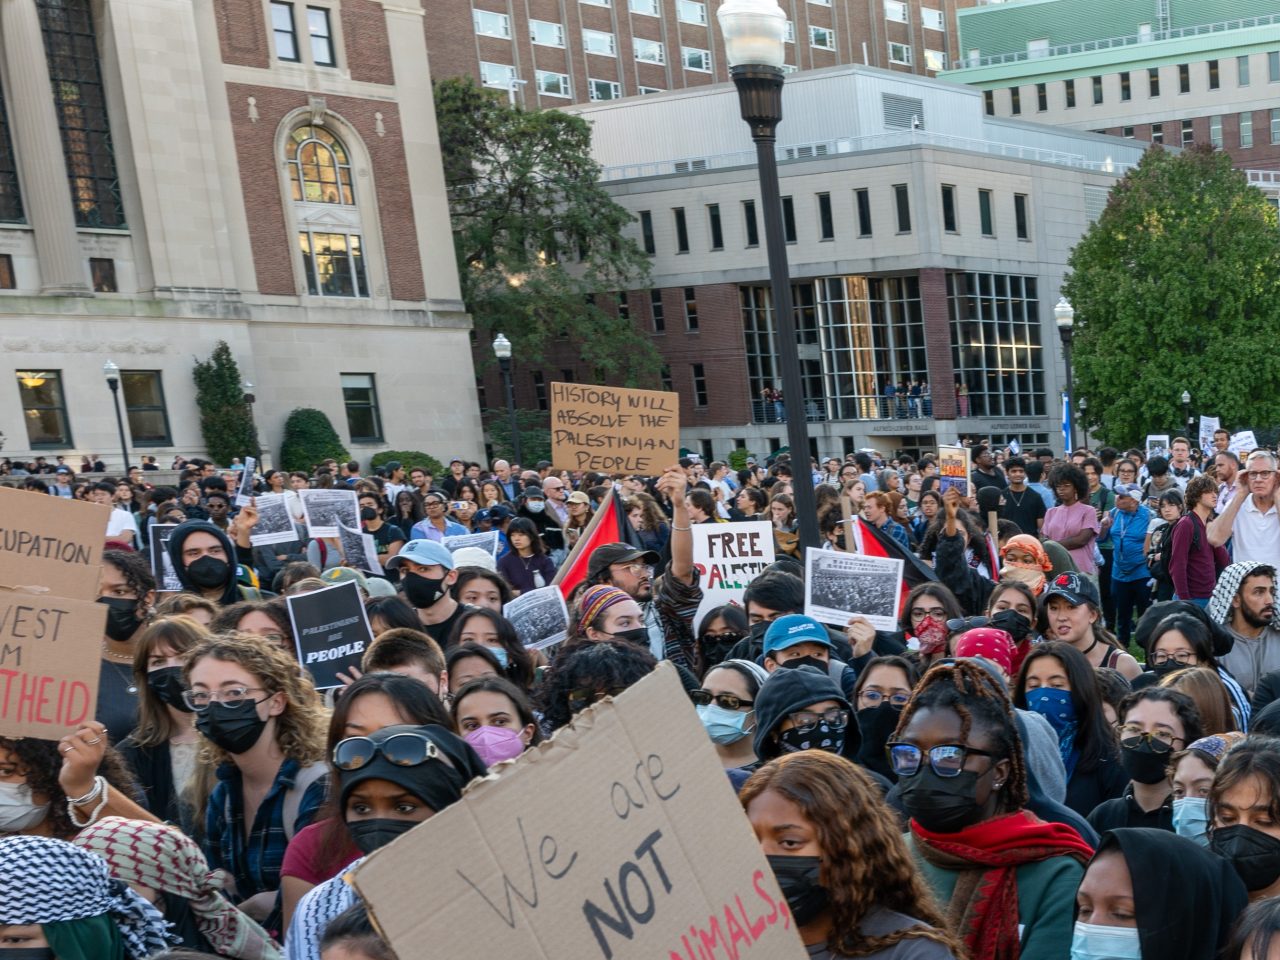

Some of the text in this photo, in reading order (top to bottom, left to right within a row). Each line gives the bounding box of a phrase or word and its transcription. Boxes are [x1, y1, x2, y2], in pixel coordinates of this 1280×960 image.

[552, 384, 673, 412] HISTORY WILL
[557, 410, 673, 428] ABSOLVE THE
[554, 430, 676, 451] PALESTINIAN
[575, 451, 652, 471] PEOPLE
[0, 529, 91, 565] UPATION
[707, 532, 763, 559] FREE
[694, 562, 773, 590] PALEST
[302, 616, 360, 636] PALESTINIANS
[306, 641, 365, 664] PEOPLE
[611, 753, 682, 820] are
[456, 816, 578, 929] We
[582, 829, 673, 960] NOT
